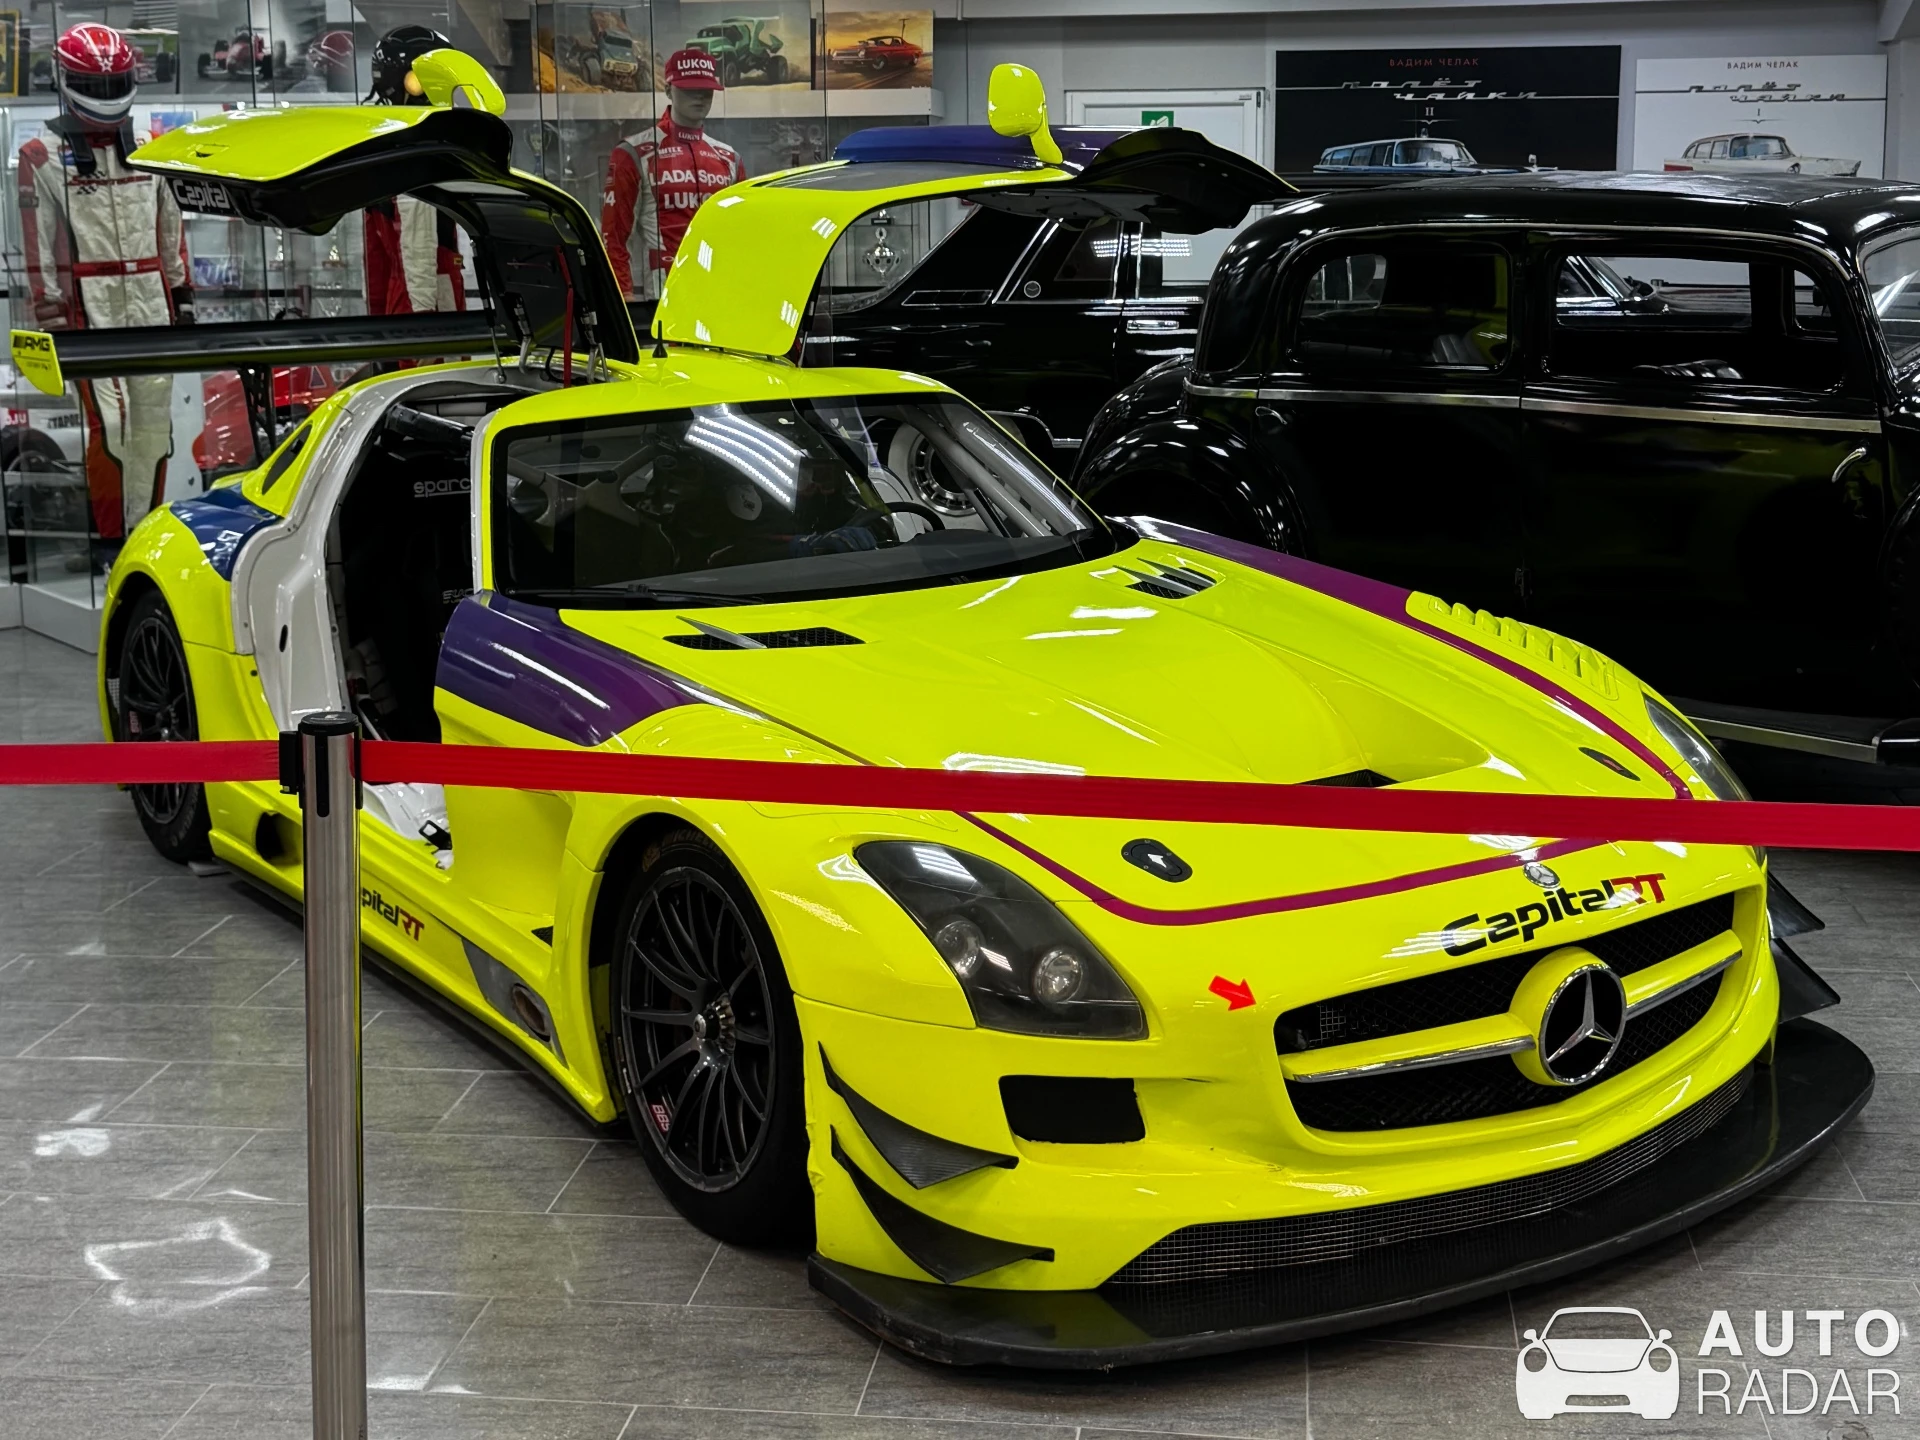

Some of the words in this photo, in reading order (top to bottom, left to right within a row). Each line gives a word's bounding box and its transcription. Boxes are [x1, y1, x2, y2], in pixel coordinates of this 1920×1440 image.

[677, 58, 715, 71] LUKOIL
[1389, 59, 1433, 67] ВАДИМ
[1439, 58, 1480, 66] ЧЕЛАК
[1727, 62, 1762, 70] ВАДИМ
[1766, 61, 1799, 69] ЧЕЛАК
[648, 169, 696, 187] LADA
[172, 179, 231, 212] Capital
[24, 335, 51, 352] AMG
[413, 477, 472, 498] sparc
[361, 886, 425, 941] pitalRT
[651, 1103, 671, 1132] BBS
